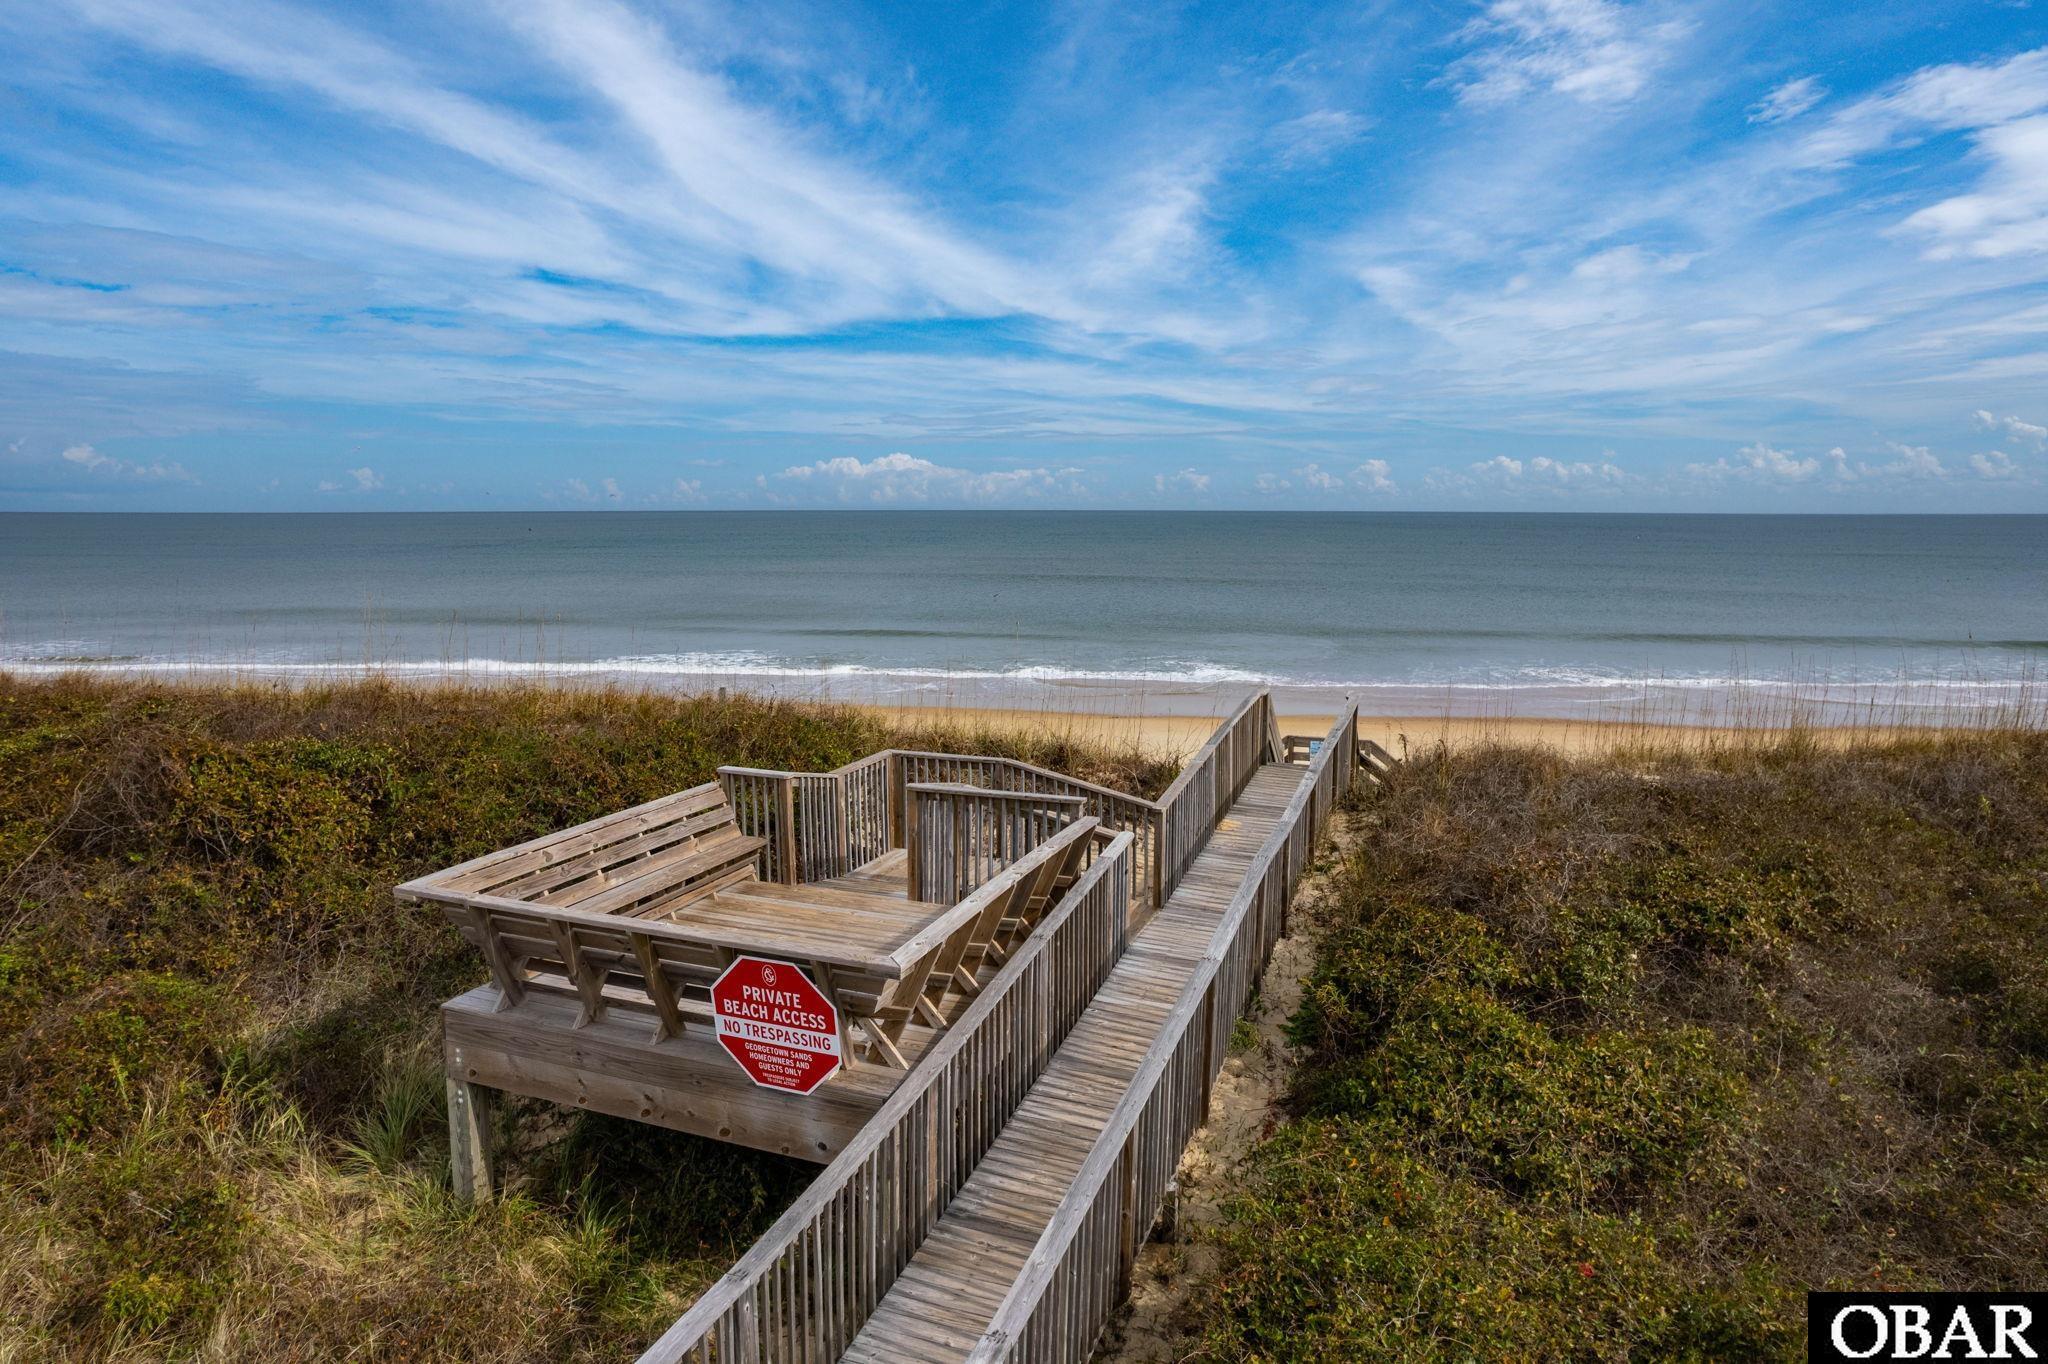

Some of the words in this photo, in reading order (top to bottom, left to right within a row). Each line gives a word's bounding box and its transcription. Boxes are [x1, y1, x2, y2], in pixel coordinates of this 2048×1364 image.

[742, 985, 801, 1008] PRIVATE
[724, 999, 768, 1019] BEACH
[774, 1008, 826, 1030] ACCESS
[724, 1019, 740, 1033] NO
[744, 1023, 831, 1050] TRESPASSING
[745, 1042, 788, 1057] GEORGETOWN
[790, 1050, 812, 1061] SANDS
[750, 1053, 794, 1066] HOMEOWNERS
[796, 1061, 809, 1069] AND
[758, 1063, 783, 1074] GUESTS
[784, 1068, 802, 1076] ONLY
